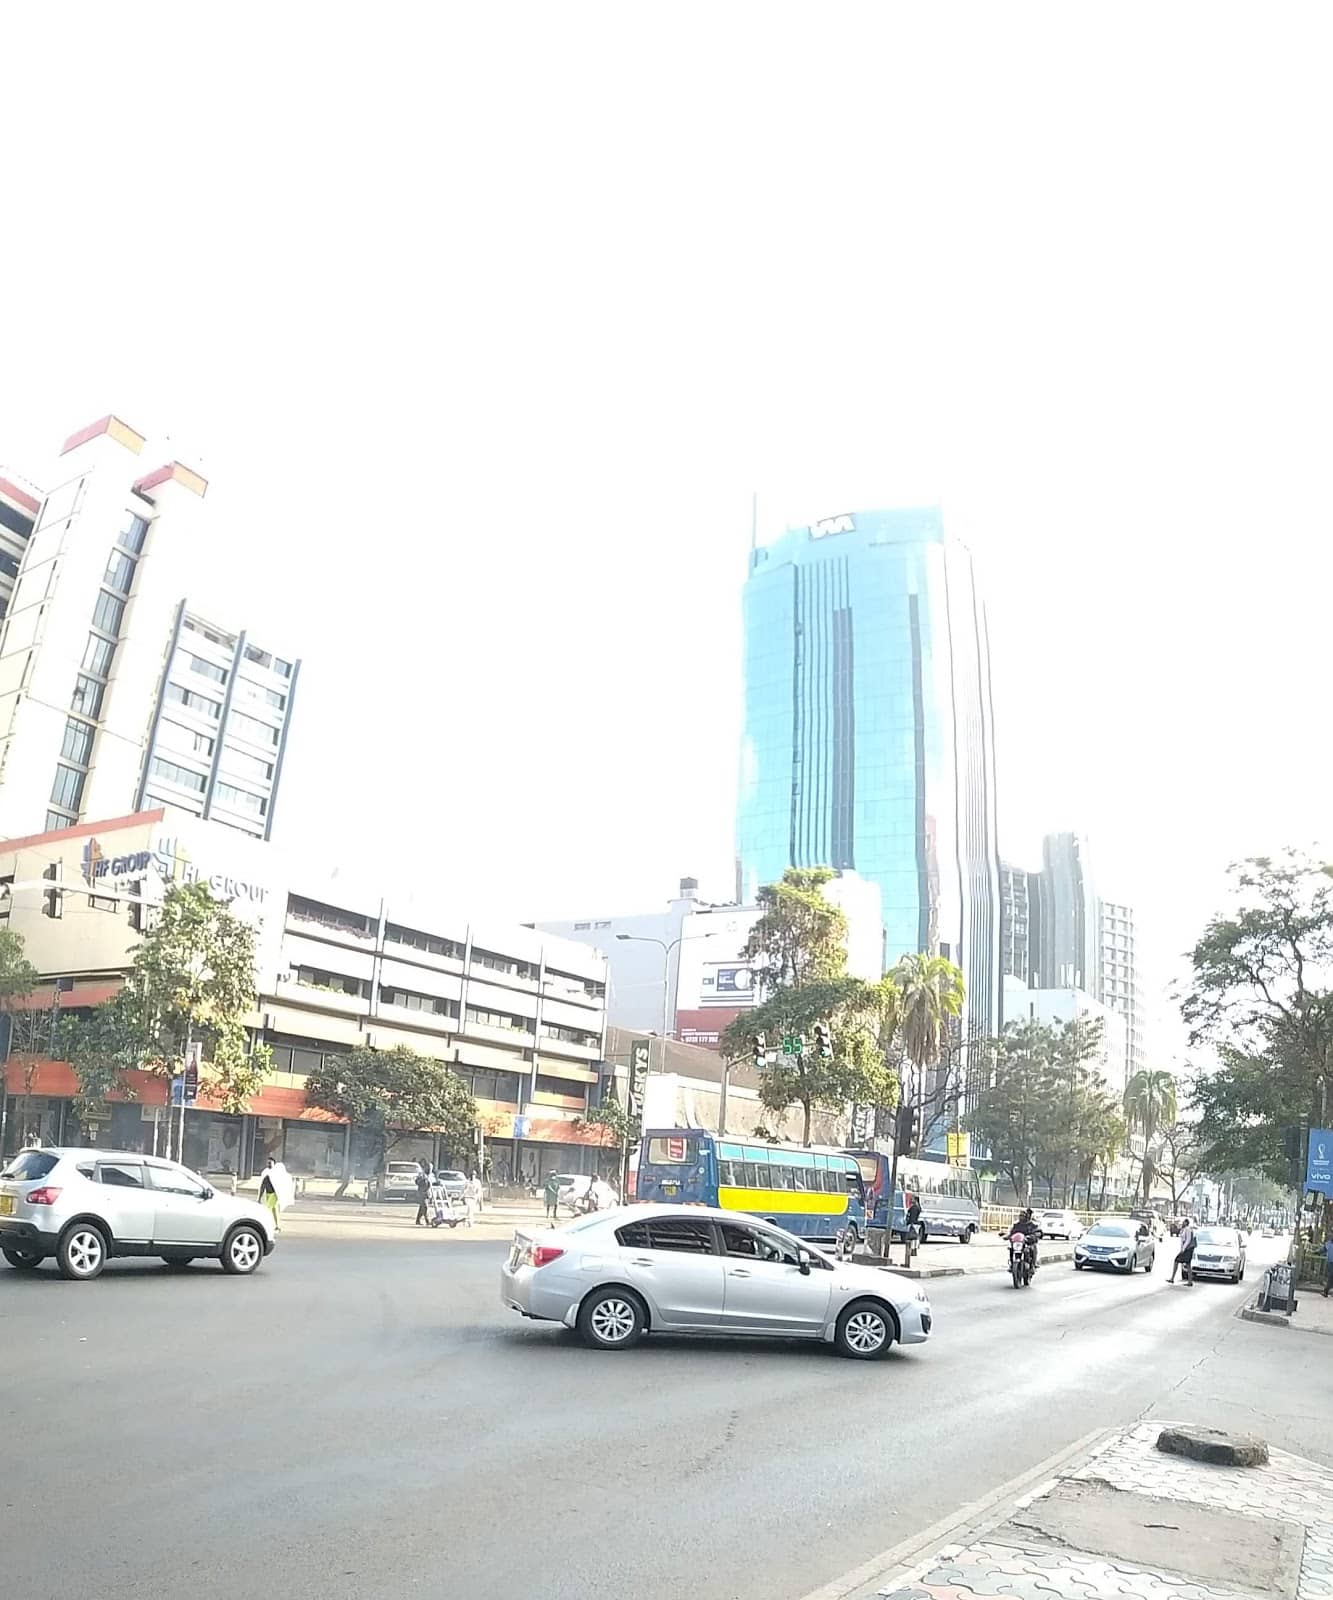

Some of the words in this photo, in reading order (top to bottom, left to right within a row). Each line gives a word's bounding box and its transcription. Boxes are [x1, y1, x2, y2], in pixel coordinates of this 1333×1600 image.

[95, 859, 109, 877] HF
[112, 851, 150, 876] GROUP
[783, 1037, 803, 1055] 55
[632, 1047, 648, 1116] TUSKYS
